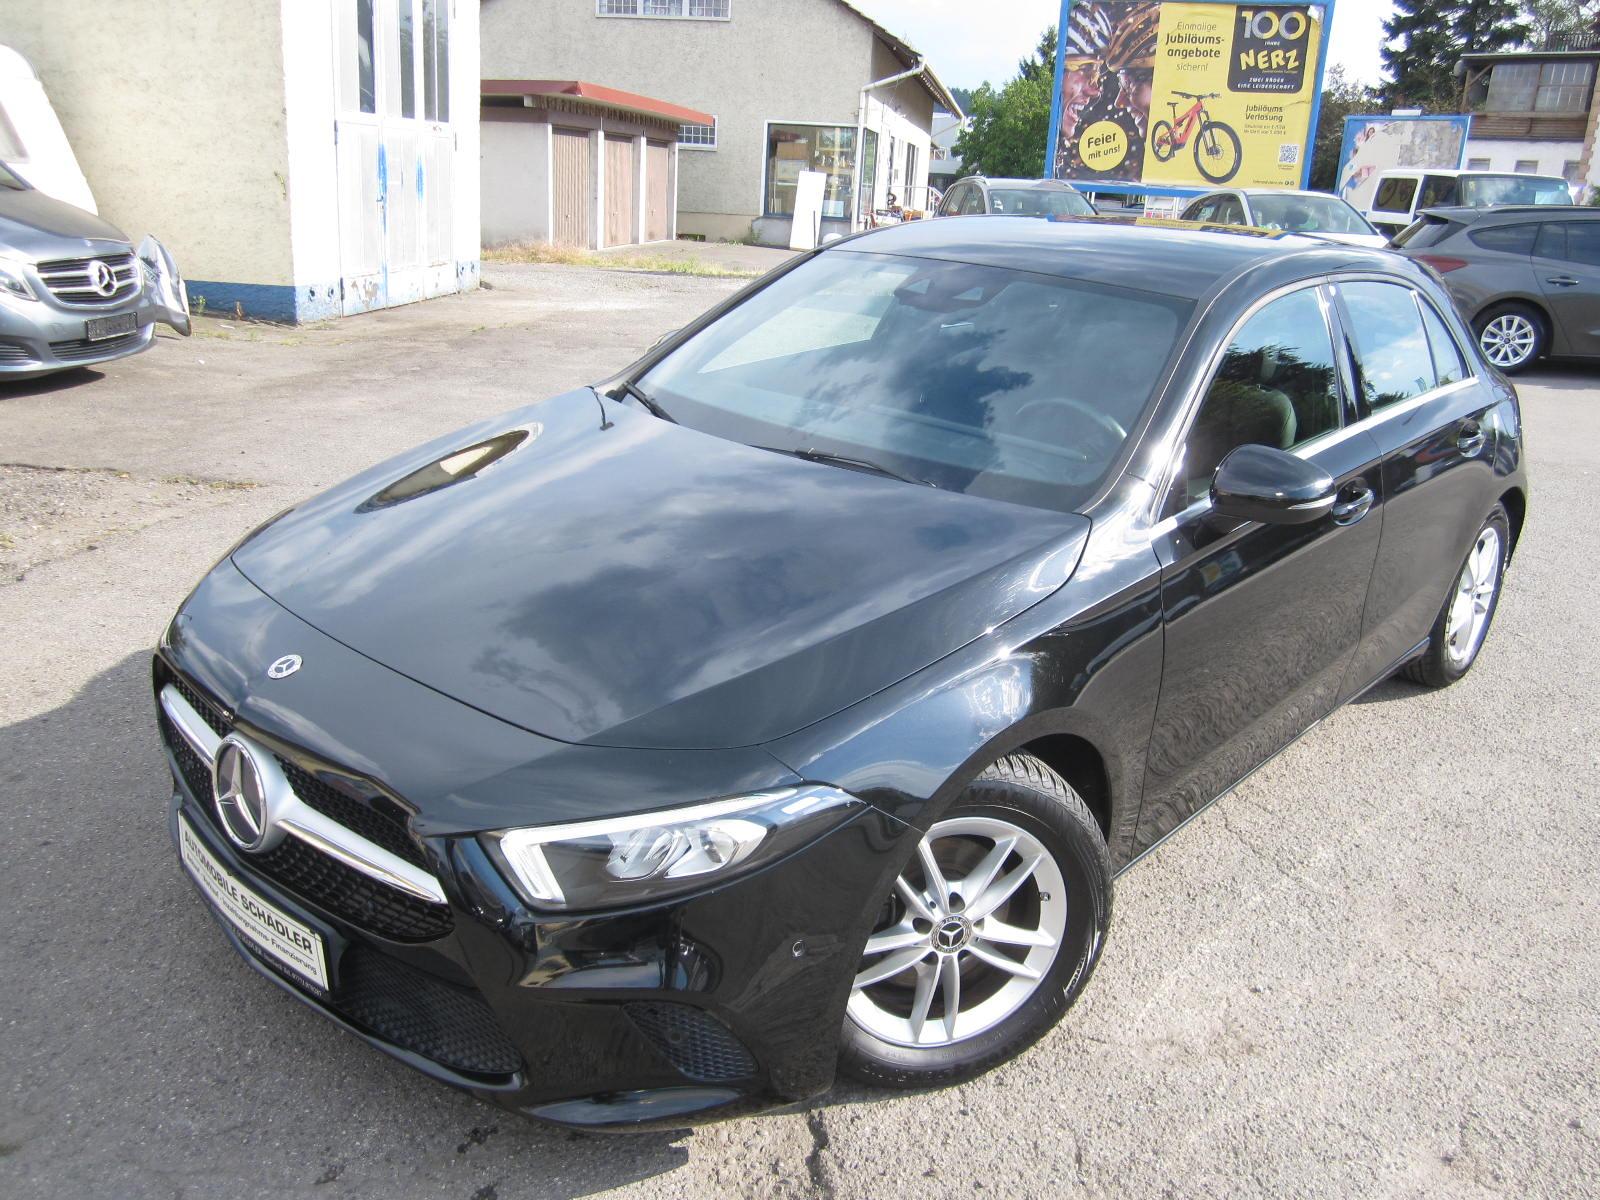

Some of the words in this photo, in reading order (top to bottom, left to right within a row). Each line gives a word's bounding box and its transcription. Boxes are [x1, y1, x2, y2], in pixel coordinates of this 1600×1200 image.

[1177, 21, 1217, 32] Einmalige
[1242, 11, 1306, 40] 100
[1165, 33, 1225, 45] Jubiläums-
[1167, 47, 1221, 59] angebote
[1239, 49, 1299, 71] NERZ
[1176, 63, 1209, 72] sichern!
[1245, 104, 1284, 113] Jubiläums
[1245, 113, 1284, 122] Verlosung
[1087, 132, 1117, 149] Feier
[1088, 150, 1102, 160] mit
[1103, 144, 1121, 156] uns!
